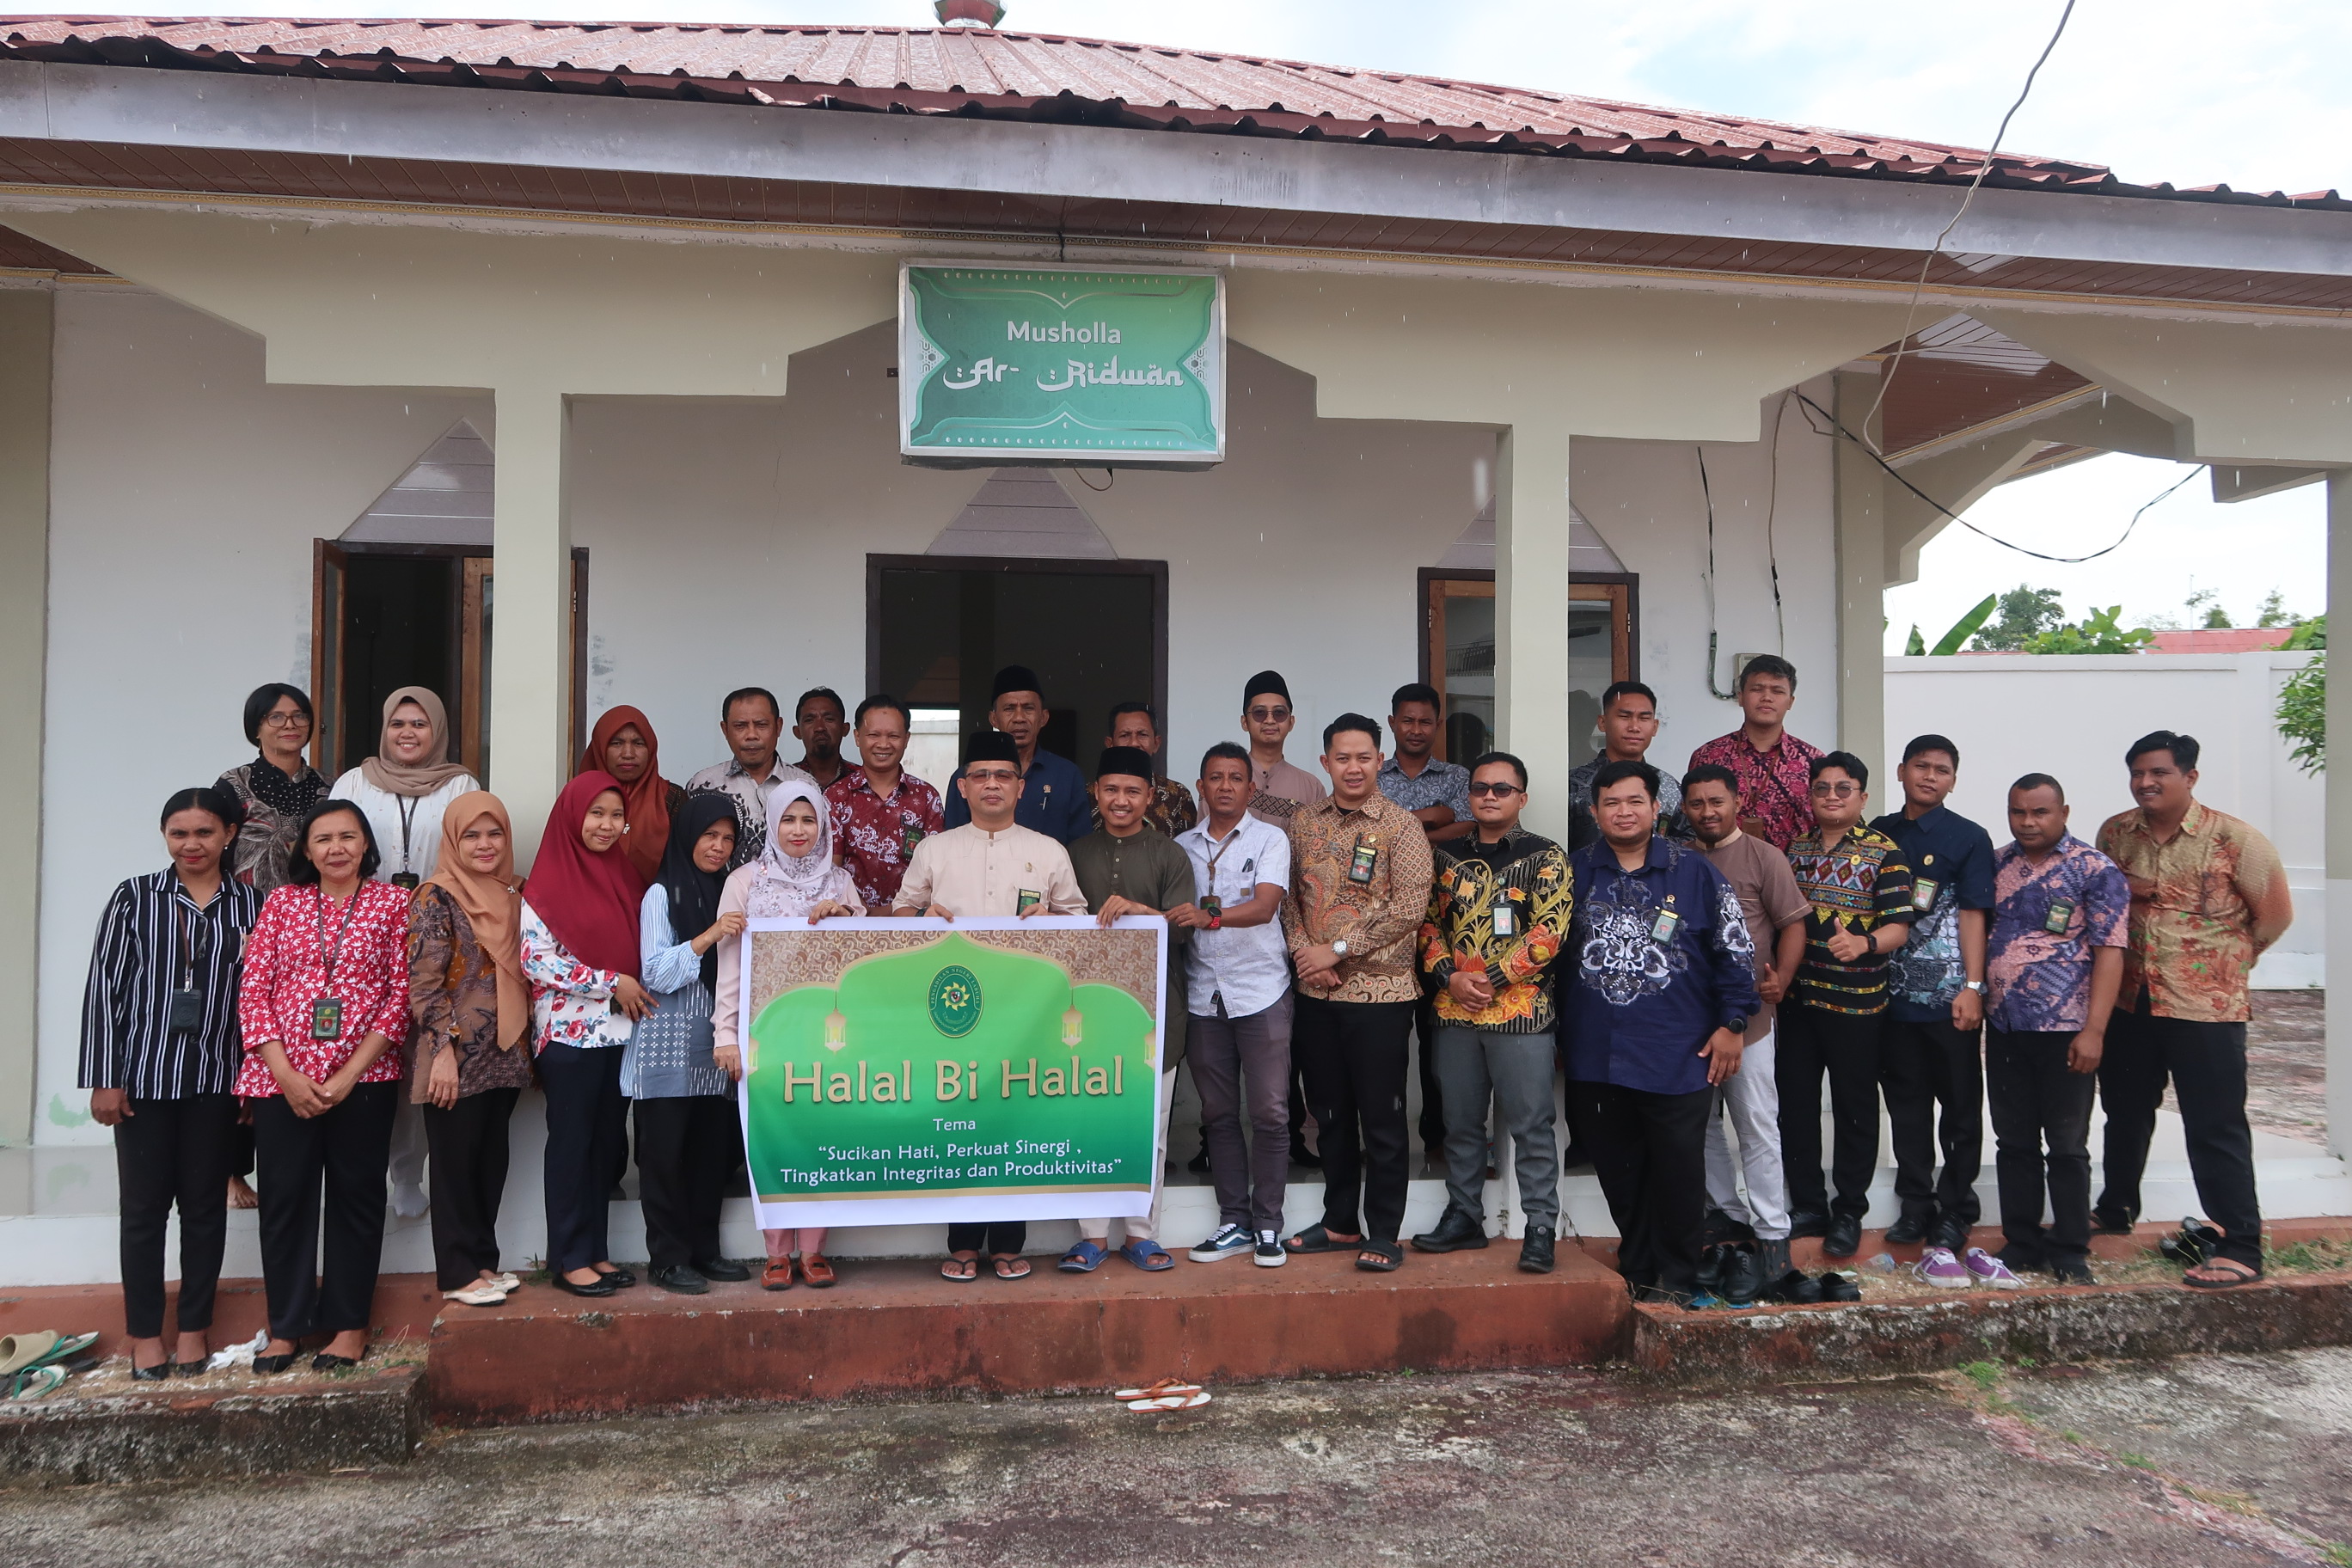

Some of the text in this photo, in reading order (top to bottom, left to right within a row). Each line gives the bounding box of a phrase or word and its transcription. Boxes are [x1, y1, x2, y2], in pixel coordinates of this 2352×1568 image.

[1007, 320, 1122, 344] Musholla
[931, 970, 950, 1004] PENGADILAN
[952, 968, 972, 980] NEGERI
[783, 1054, 1124, 1103] Halal Bi Halal
[933, 1118, 977, 1131] Tema
[898, 1145, 940, 1160] Hati,
[946, 1142, 1009, 1158] Perkuat
[780, 1167, 876, 1187] Tingkatkan
[883, 1165, 961, 1184] Integritas
[967, 1163, 998, 1178] dan
